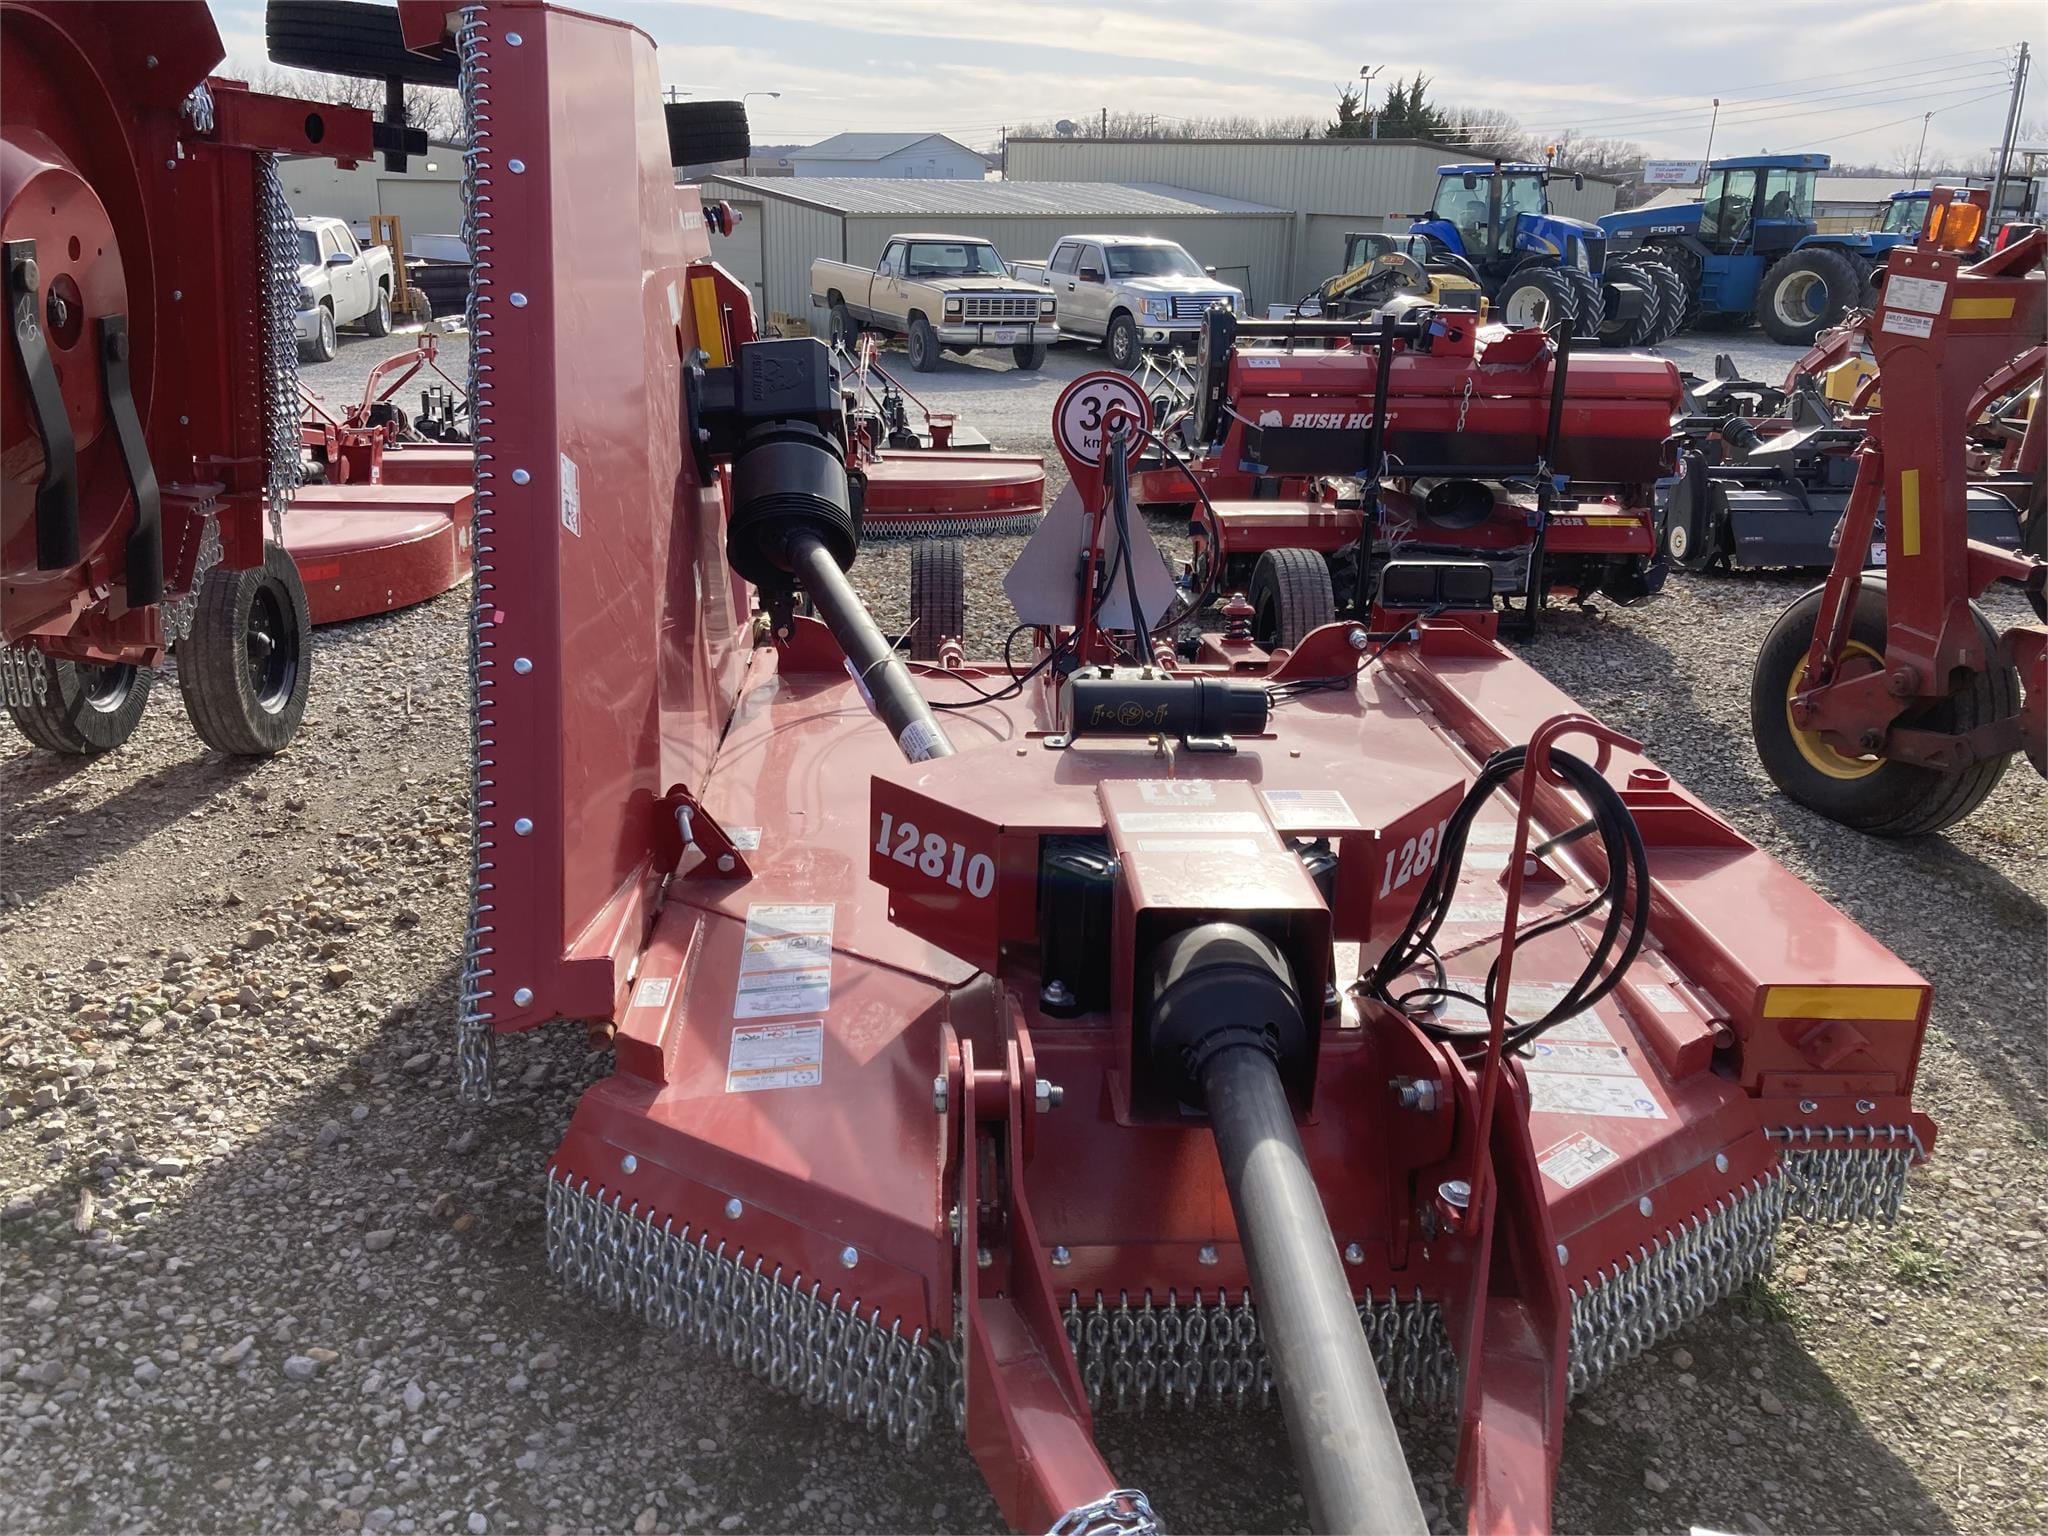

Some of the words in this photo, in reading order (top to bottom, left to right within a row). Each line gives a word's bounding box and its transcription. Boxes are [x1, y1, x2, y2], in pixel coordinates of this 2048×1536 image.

[1080, 396, 1126, 432] 30
[1290, 413, 1346, 430] BUSH
[876, 812, 995, 898] 12810
[1379, 818, 1448, 899] 1281
